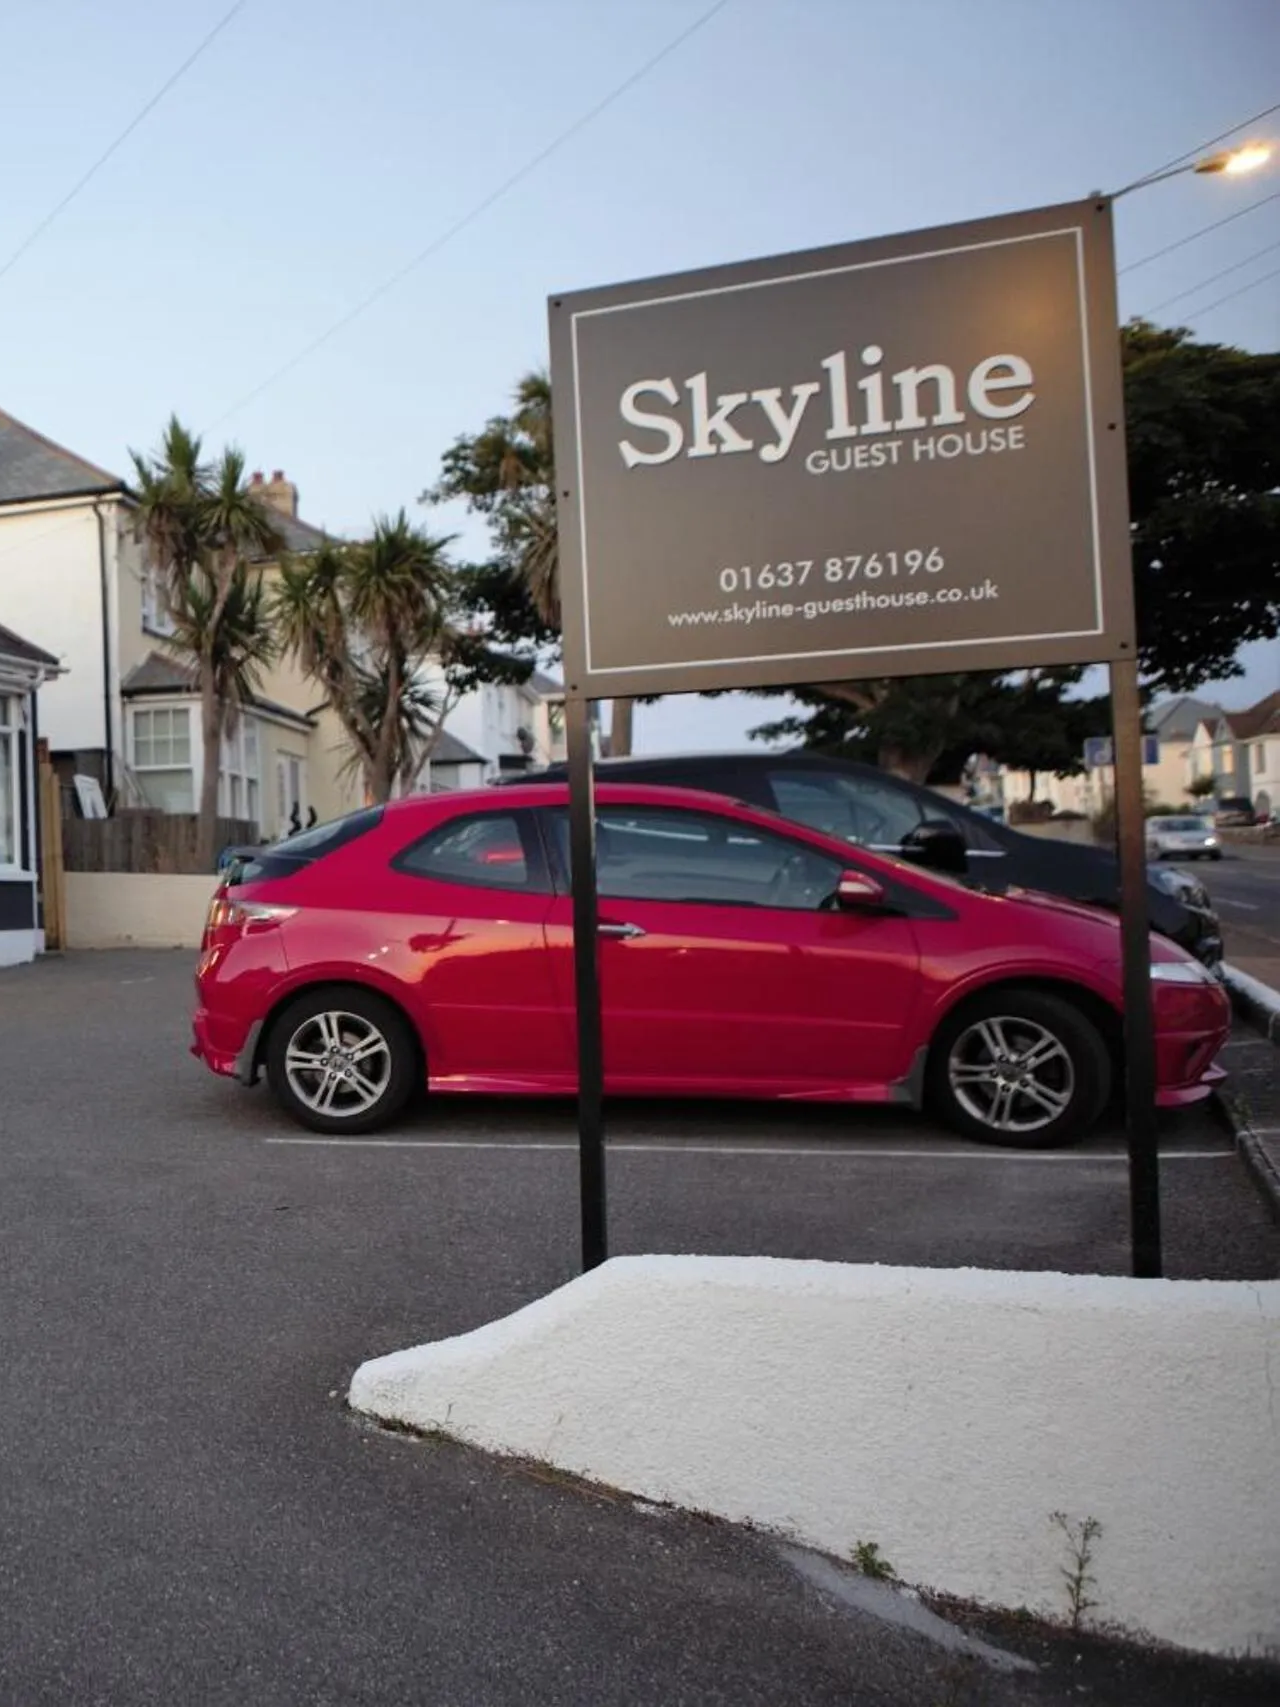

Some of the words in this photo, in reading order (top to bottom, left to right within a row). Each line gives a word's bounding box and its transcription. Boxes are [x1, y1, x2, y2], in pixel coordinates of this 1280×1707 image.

[619, 345, 1036, 467] Skyline
[806, 440, 903, 474] GUEST
[913, 425, 1025, 462] HOUSE
[719, 560, 813, 593] 01637
[824, 546, 945, 584] 876196
[668, 579, 998, 626] www.skyline-guesthouse.co.uk
